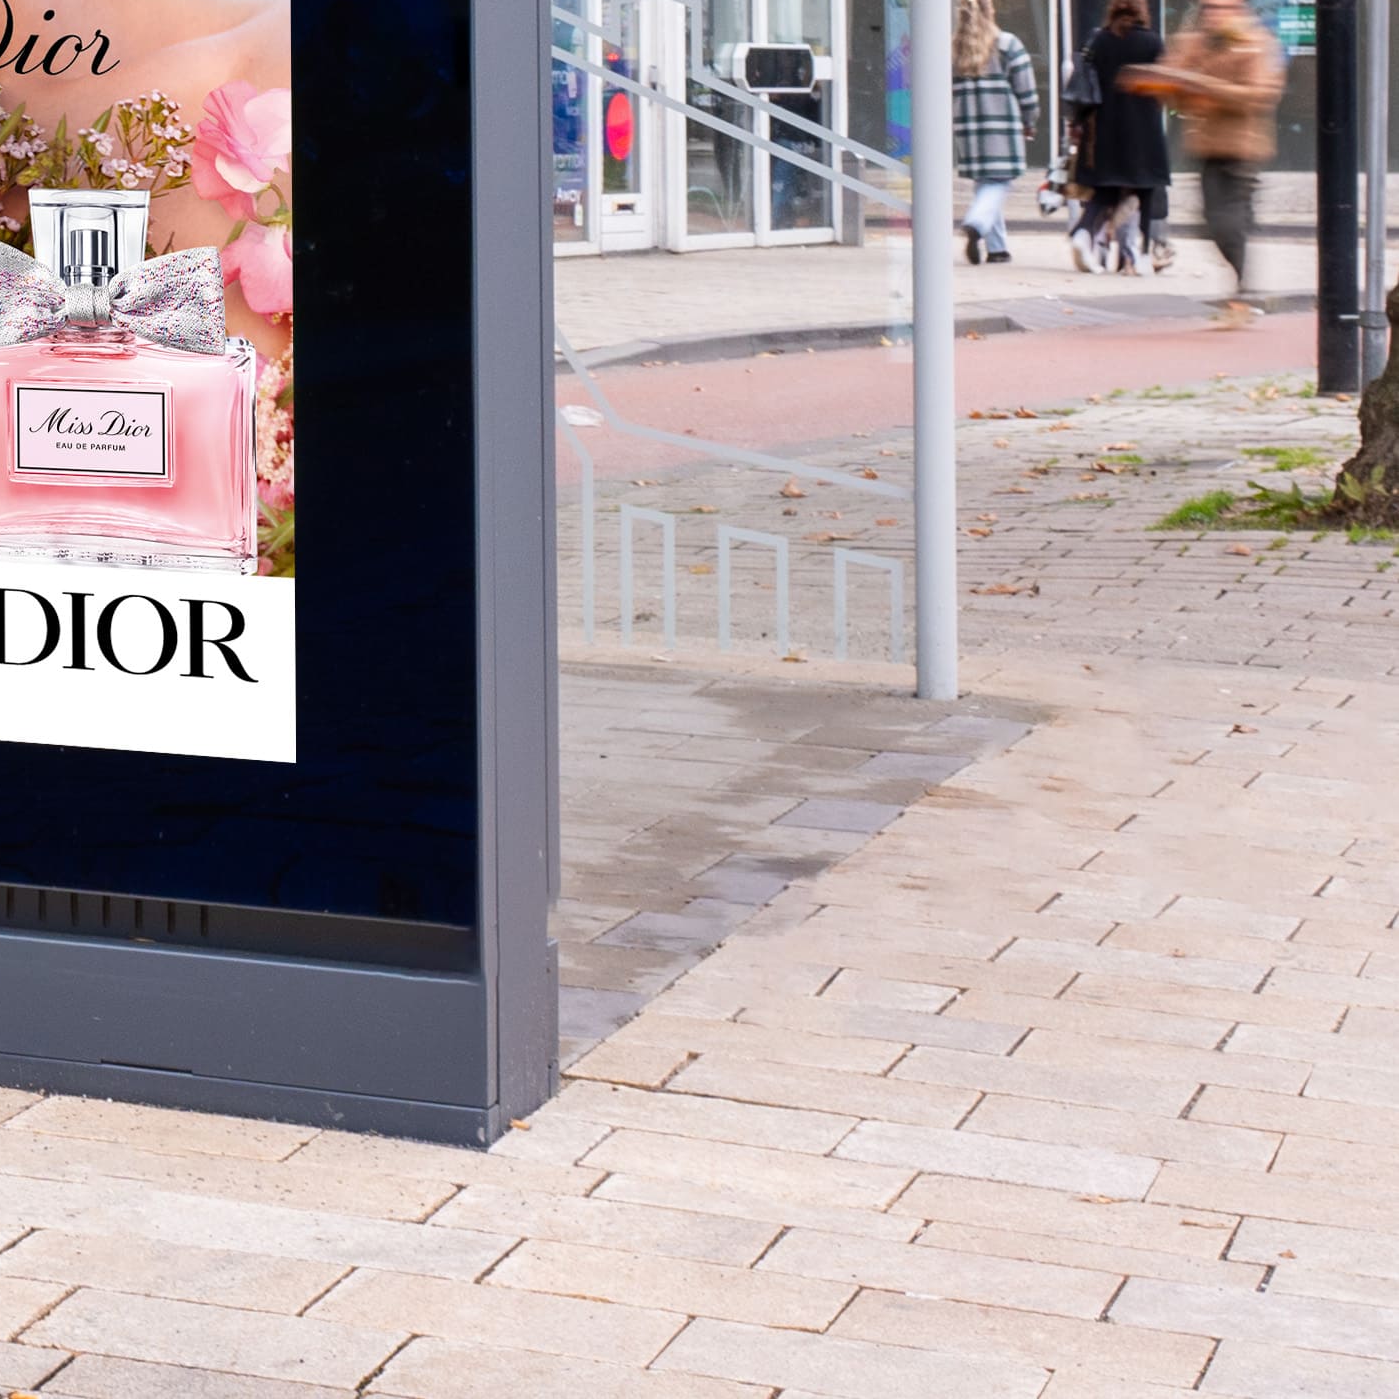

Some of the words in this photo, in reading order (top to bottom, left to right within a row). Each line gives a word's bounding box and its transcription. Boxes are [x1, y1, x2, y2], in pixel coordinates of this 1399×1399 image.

[28, 407, 93, 435] Miss
[97, 410, 152, 437] Dior
[90, 443, 126, 451] PARFUM
